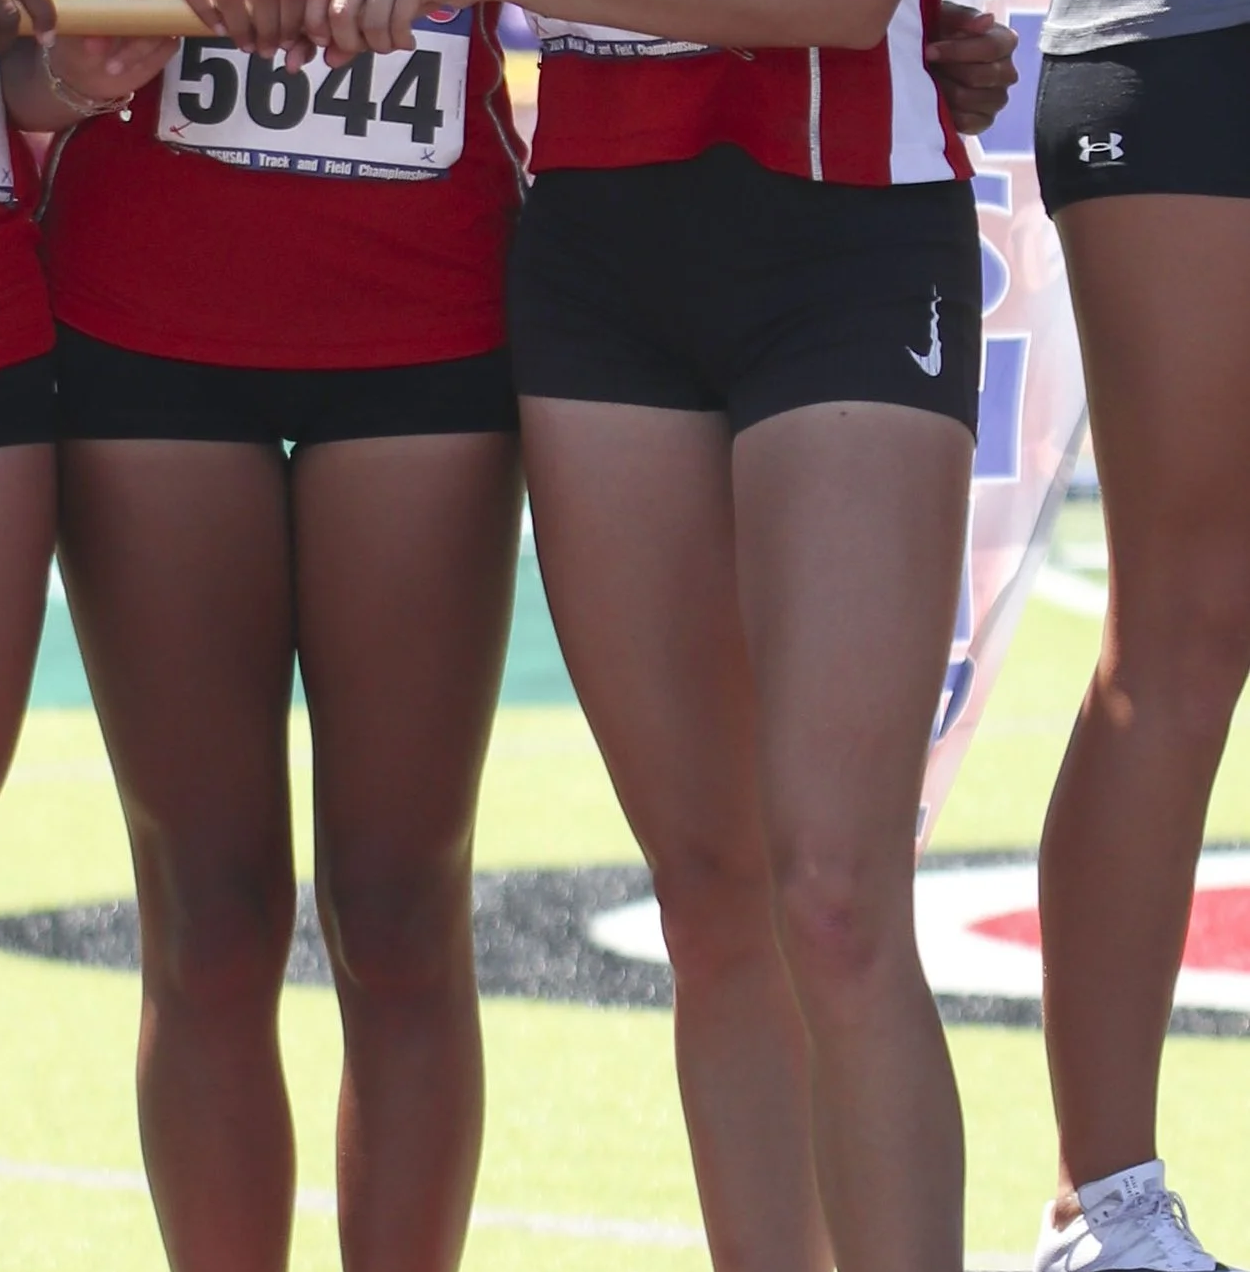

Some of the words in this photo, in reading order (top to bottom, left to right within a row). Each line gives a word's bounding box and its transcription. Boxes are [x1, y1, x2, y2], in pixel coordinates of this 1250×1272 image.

[178, 36, 444, 145] 5644
[259, 153, 290, 169] Track
[297, 158, 318, 172] and
[325, 160, 352, 175] Field
